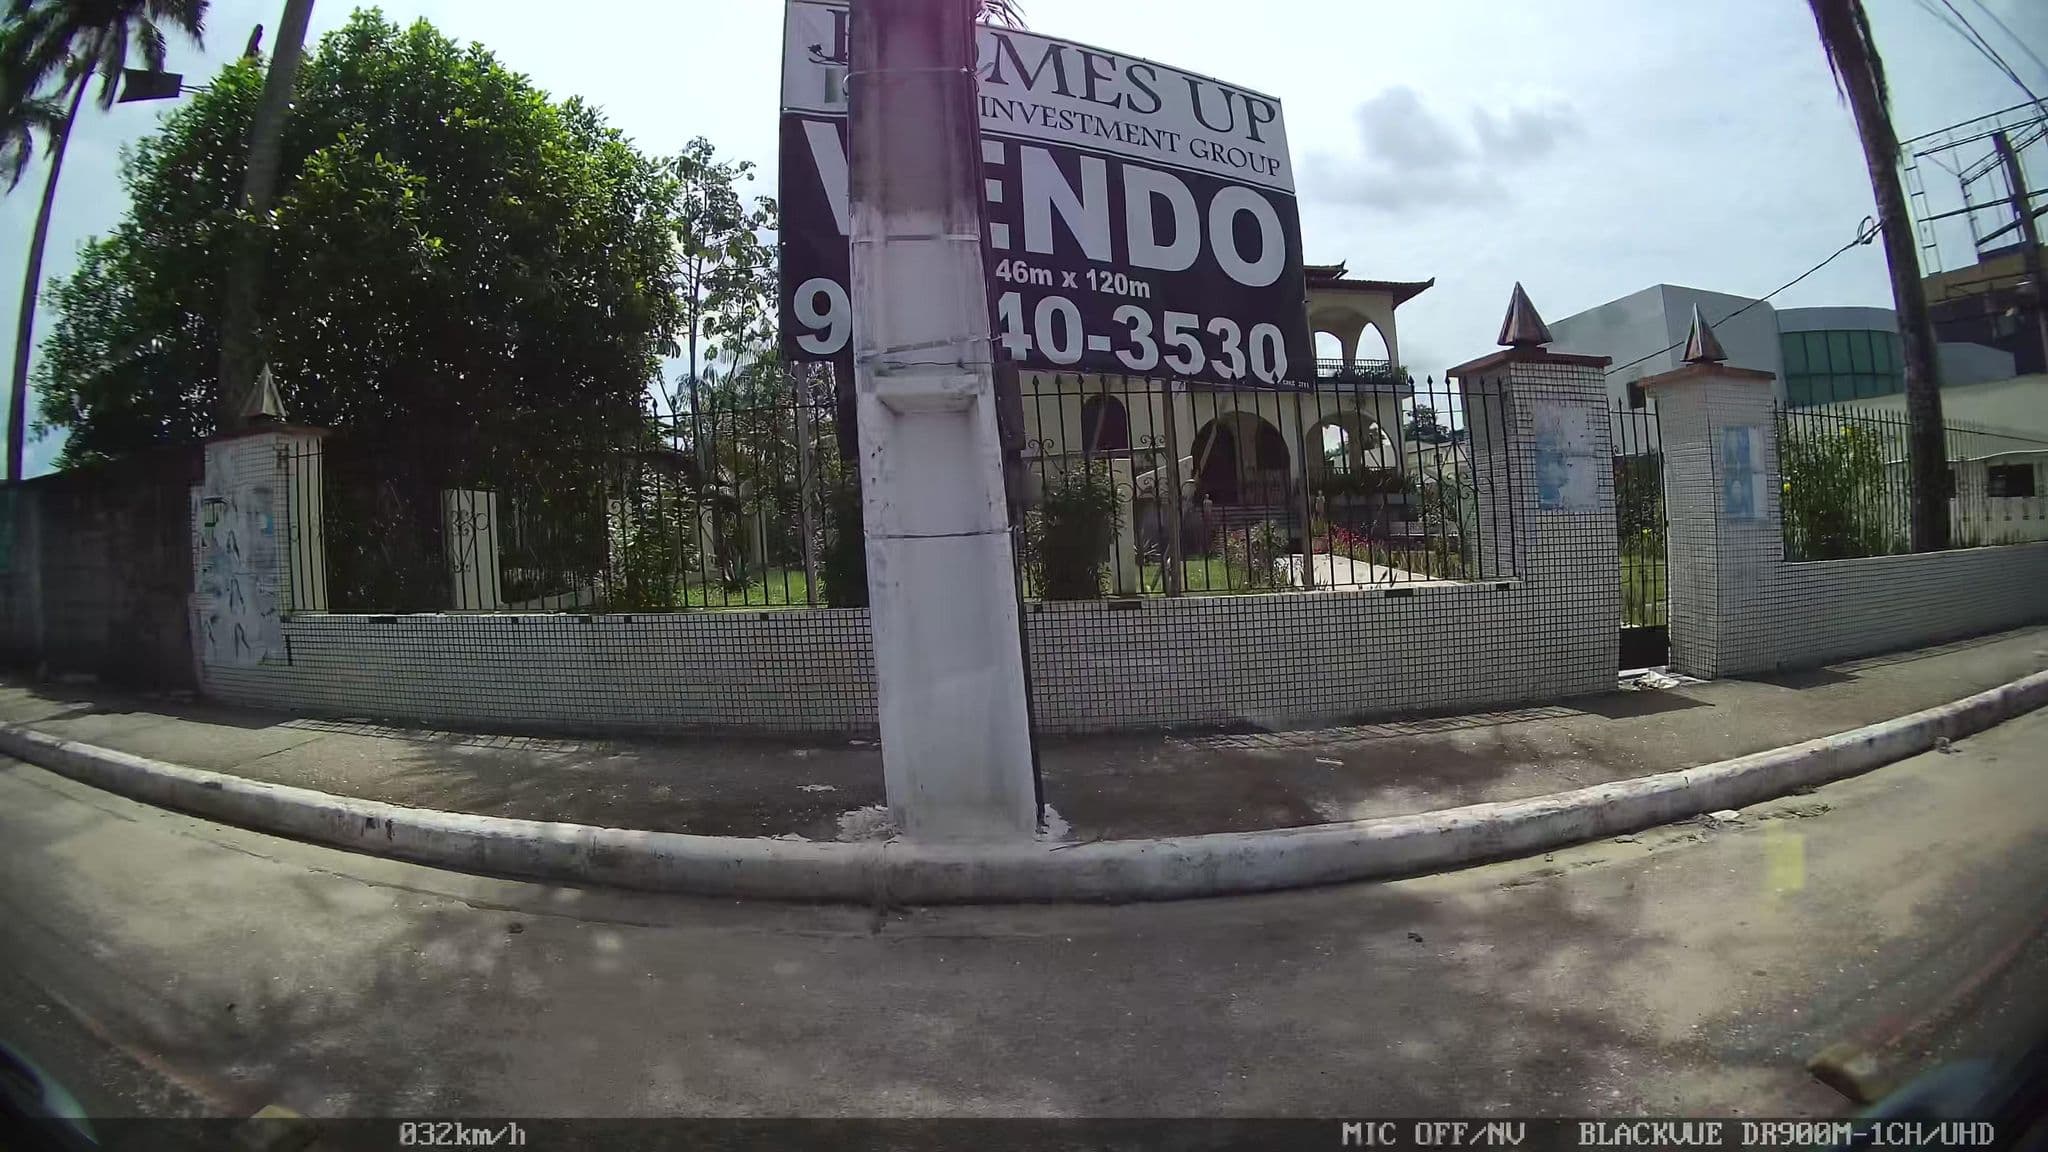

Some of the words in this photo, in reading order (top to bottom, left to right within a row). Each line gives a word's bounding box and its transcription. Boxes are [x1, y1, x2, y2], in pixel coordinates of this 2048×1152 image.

[980, 95, 1180, 153] INVESTMENT
[1190, 138, 1280, 177] GROUP
[1182, 76, 1276, 144] UP
[995, 259, 1053, 286] 46m
[1061, 270, 1078, 289] x
[1086, 268, 1151, 299] 120m
[793, 277, 1288, 385] 940-3530
